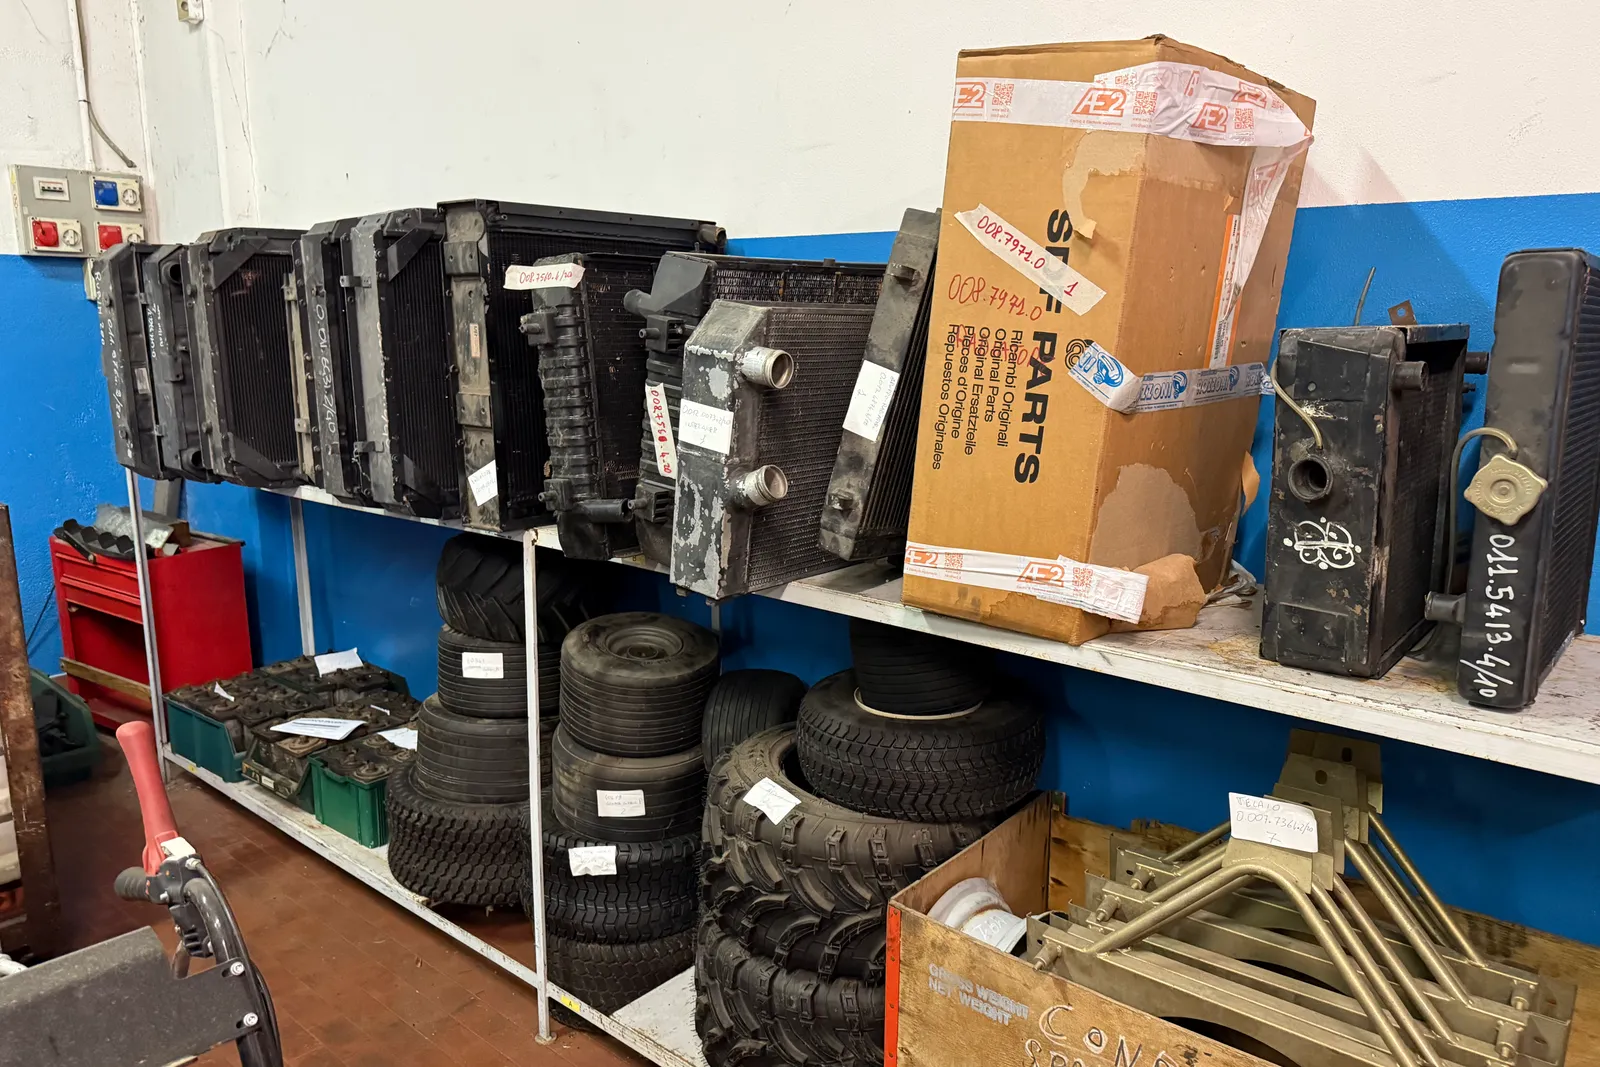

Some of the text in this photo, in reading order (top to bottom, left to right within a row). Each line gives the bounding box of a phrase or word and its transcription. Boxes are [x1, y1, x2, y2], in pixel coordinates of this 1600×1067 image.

[977, 215, 1046, 270] 008.7971.0
[932, 323, 960, 470] Repuestos Originales
[964, 326, 990, 455] Original Ersatzteile
[984, 328, 1006, 423] Original Parts
[997, 330, 1023, 447] Ricambi Originali
[1014, 331, 1058, 483] PARTS
[959, 993, 1012, 1026] WEIGHT
[976, 983, 1030, 1020] WEIGHT
